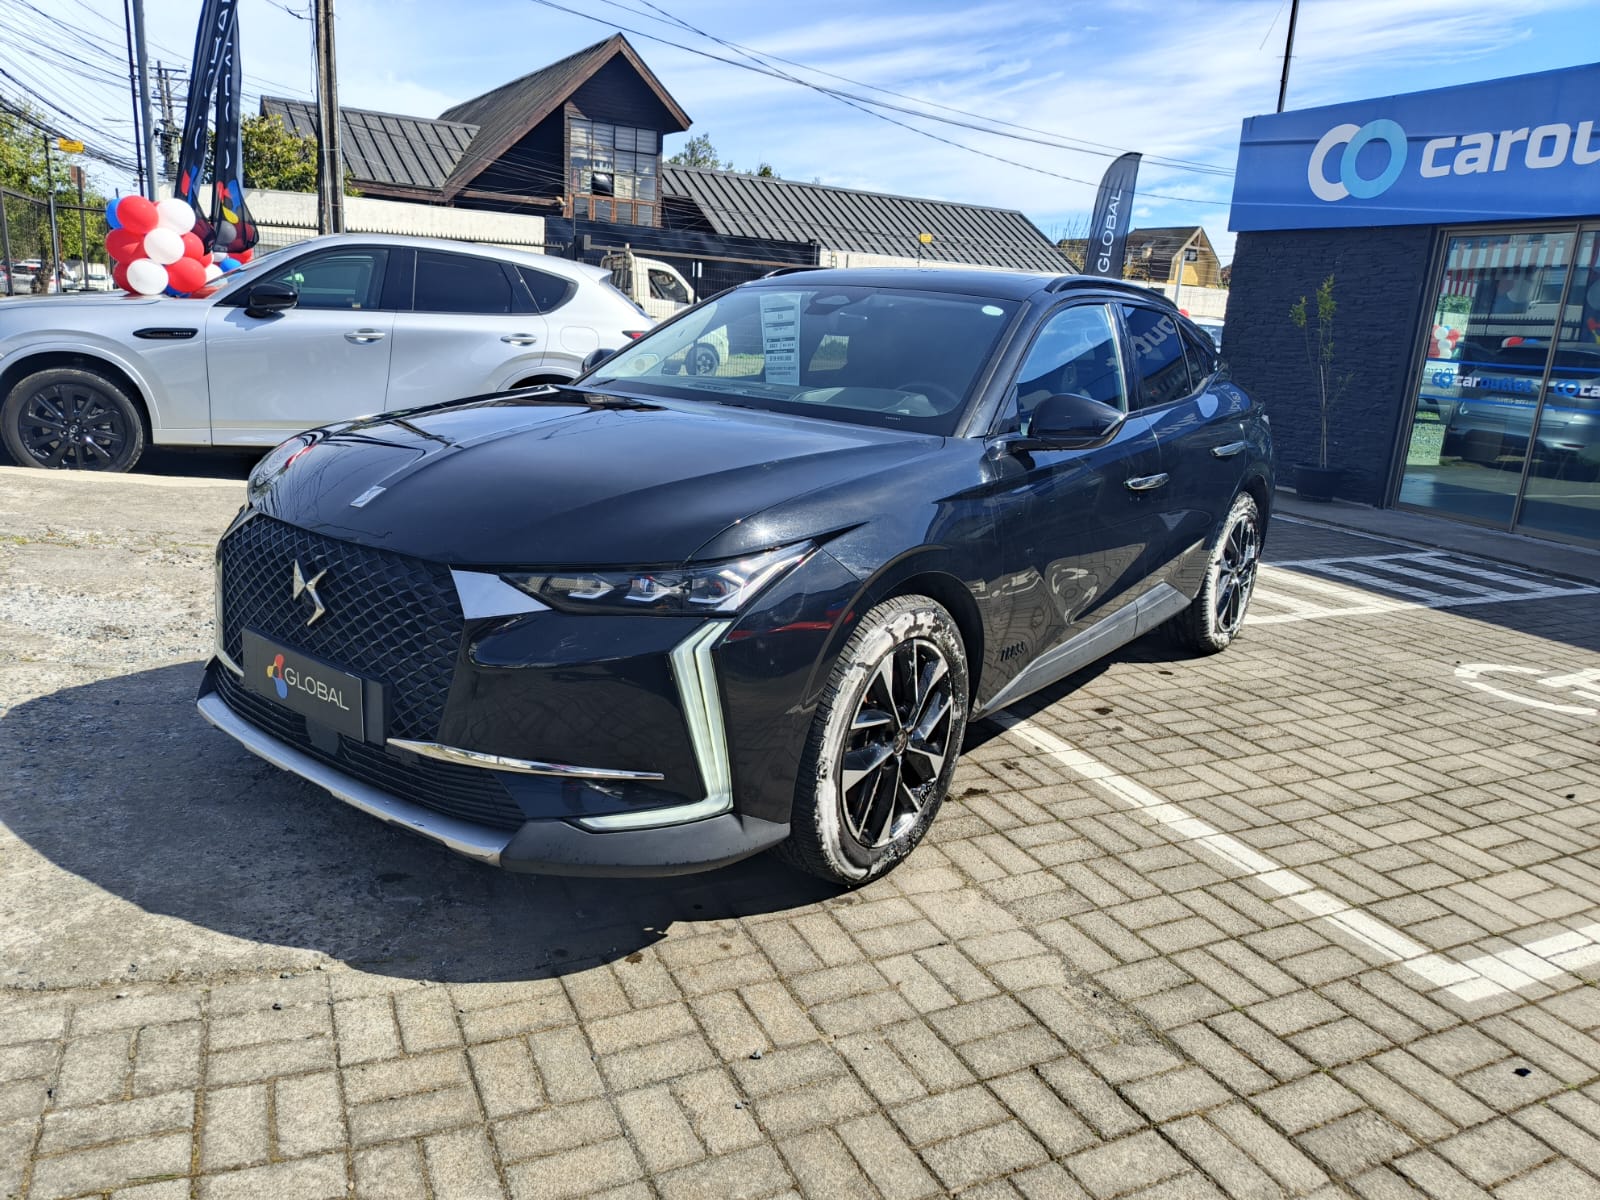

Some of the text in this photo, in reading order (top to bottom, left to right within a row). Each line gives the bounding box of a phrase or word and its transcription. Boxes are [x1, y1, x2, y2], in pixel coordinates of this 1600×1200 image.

[1420, 120, 1600, 178] carou
[1098, 189, 1122, 273] GLOBAL
[1453, 375, 1533, 393] caroutlet
[285, 667, 349, 710] GLOBAL
